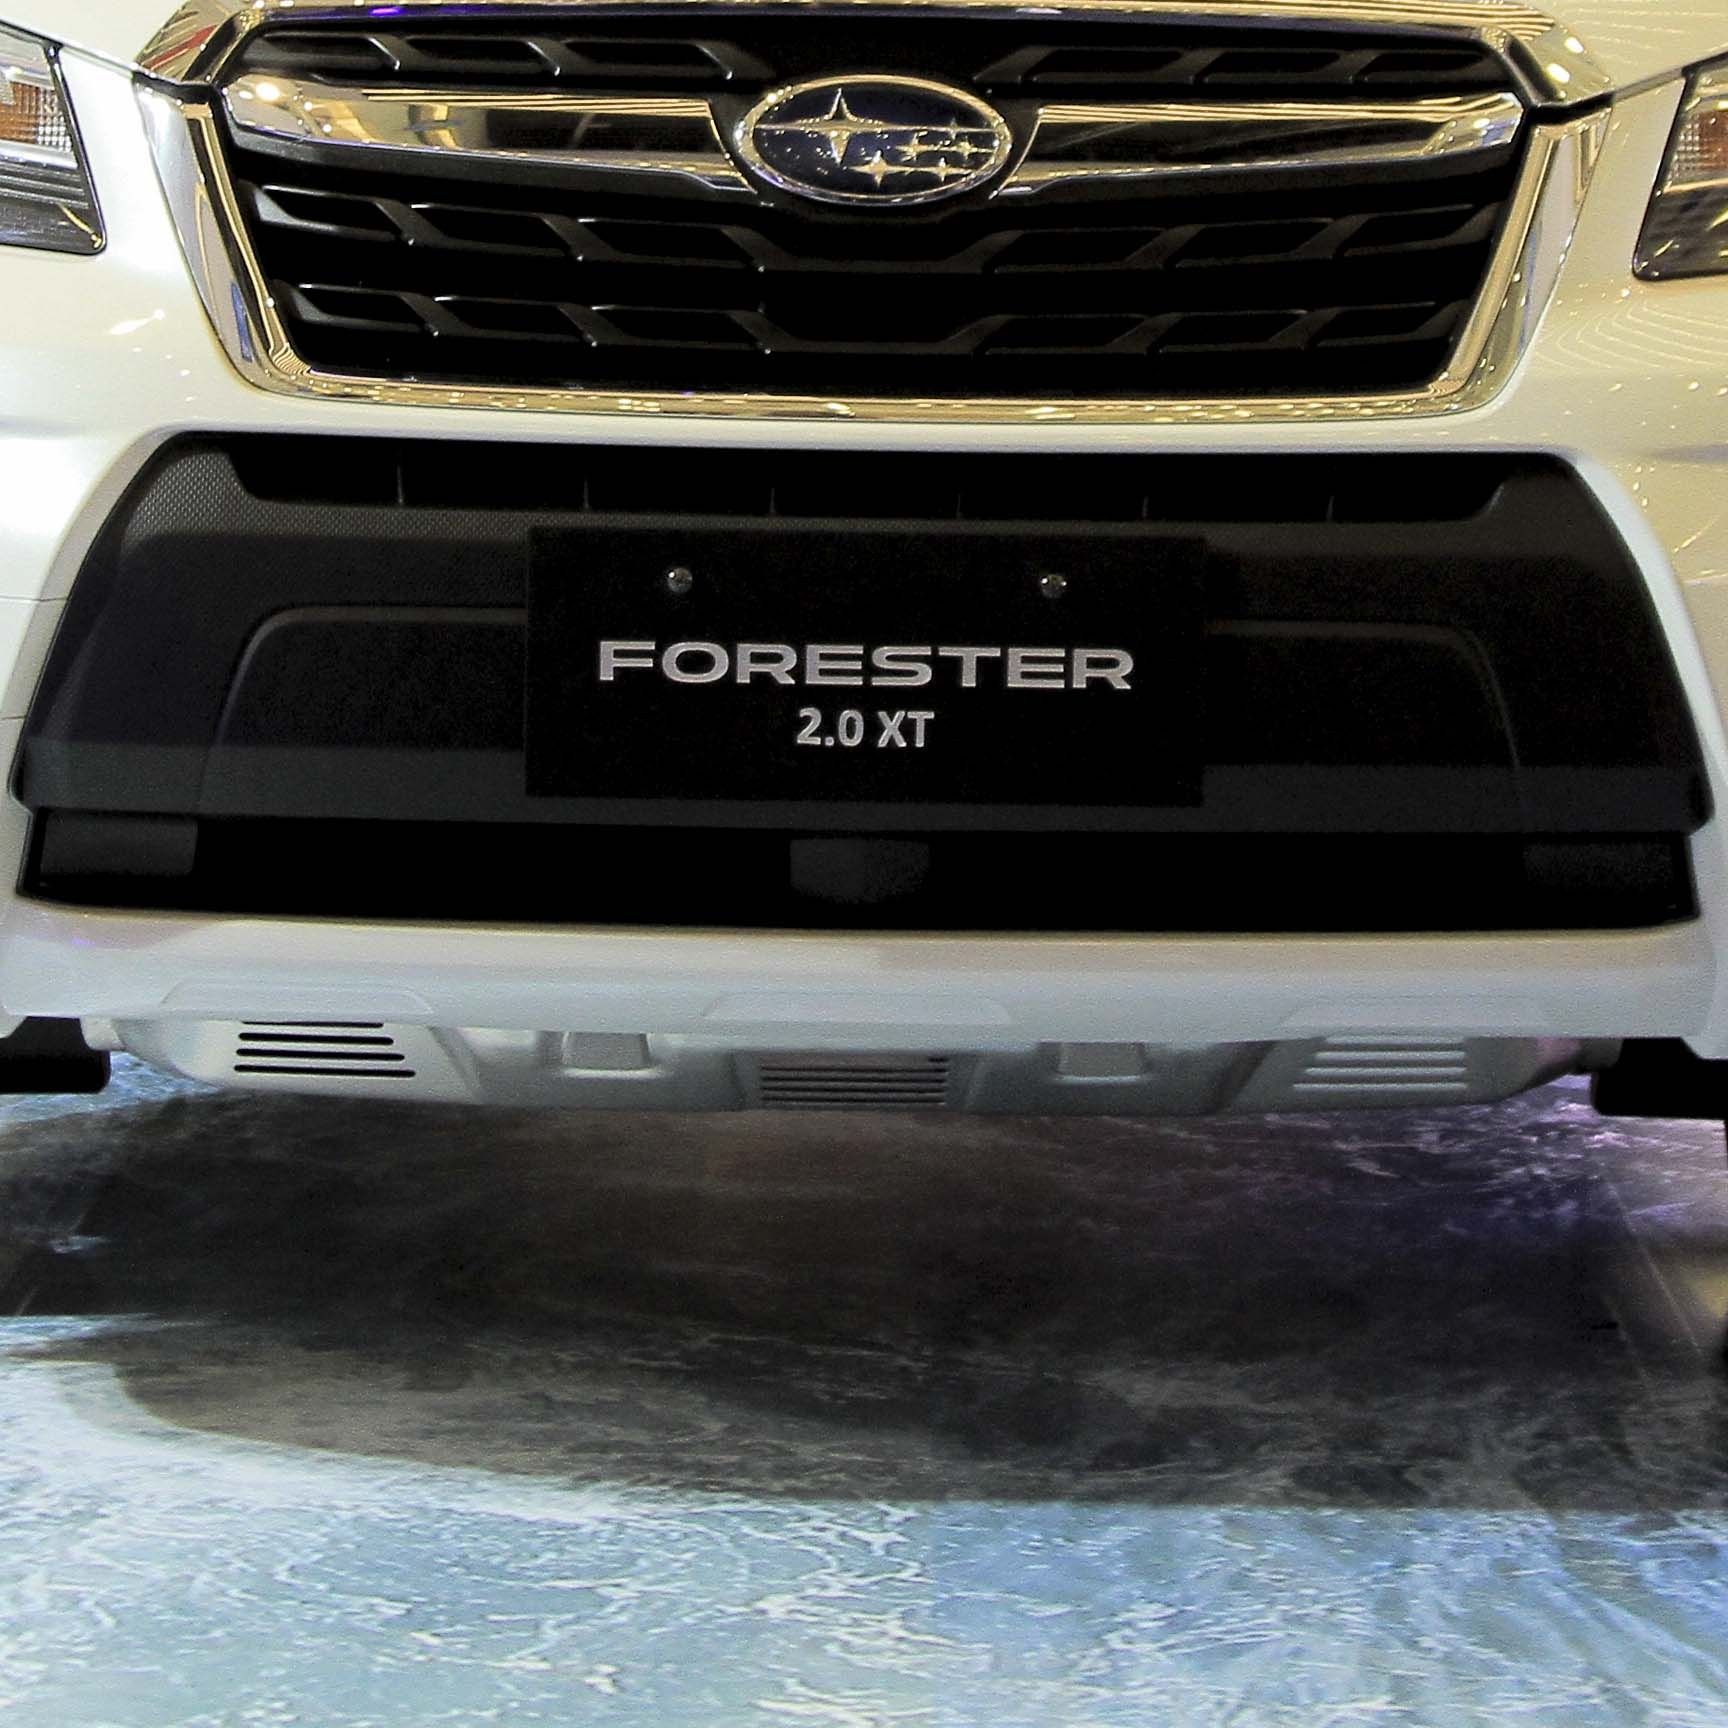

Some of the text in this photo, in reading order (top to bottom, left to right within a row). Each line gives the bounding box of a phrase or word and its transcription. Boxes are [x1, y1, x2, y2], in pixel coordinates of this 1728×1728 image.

[598, 640, 1135, 690] FORESTER
[796, 707, 935, 748] 2.0 XT
